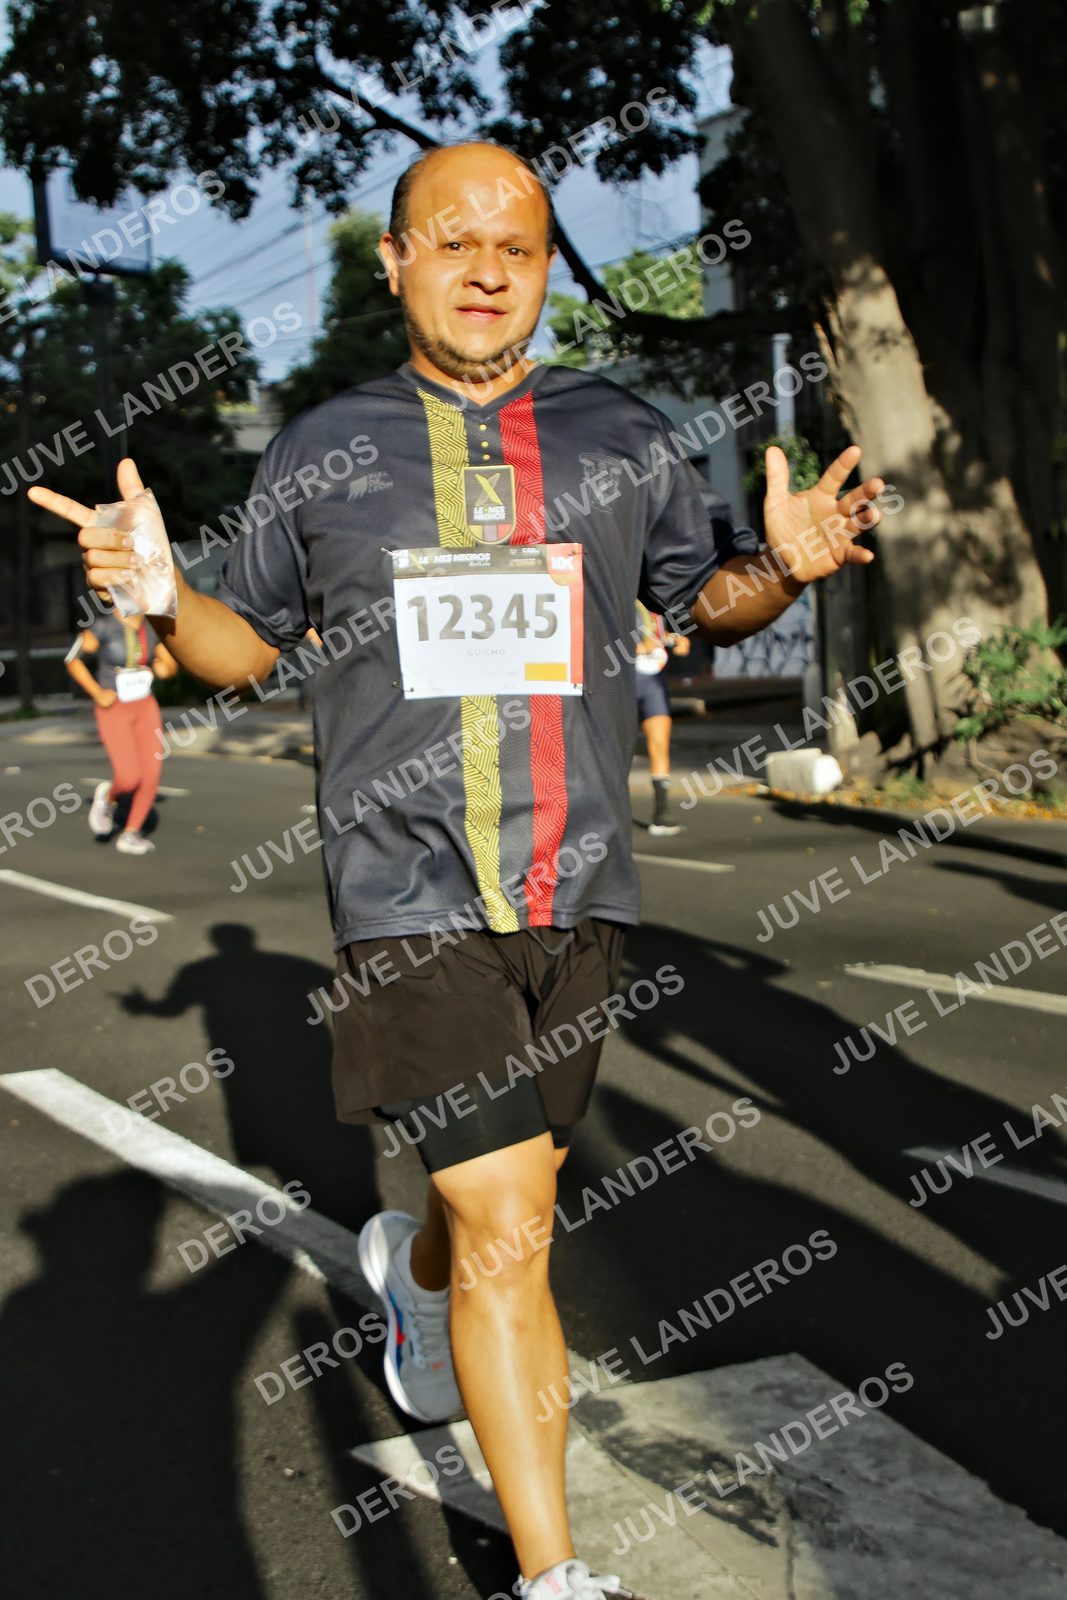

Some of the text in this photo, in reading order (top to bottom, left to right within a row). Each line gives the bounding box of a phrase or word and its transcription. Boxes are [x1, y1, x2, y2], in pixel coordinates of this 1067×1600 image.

[551, 556, 575, 570] 10K
[407, 592, 558, 642] 12345
[467, 648, 506, 657] GUICHO
